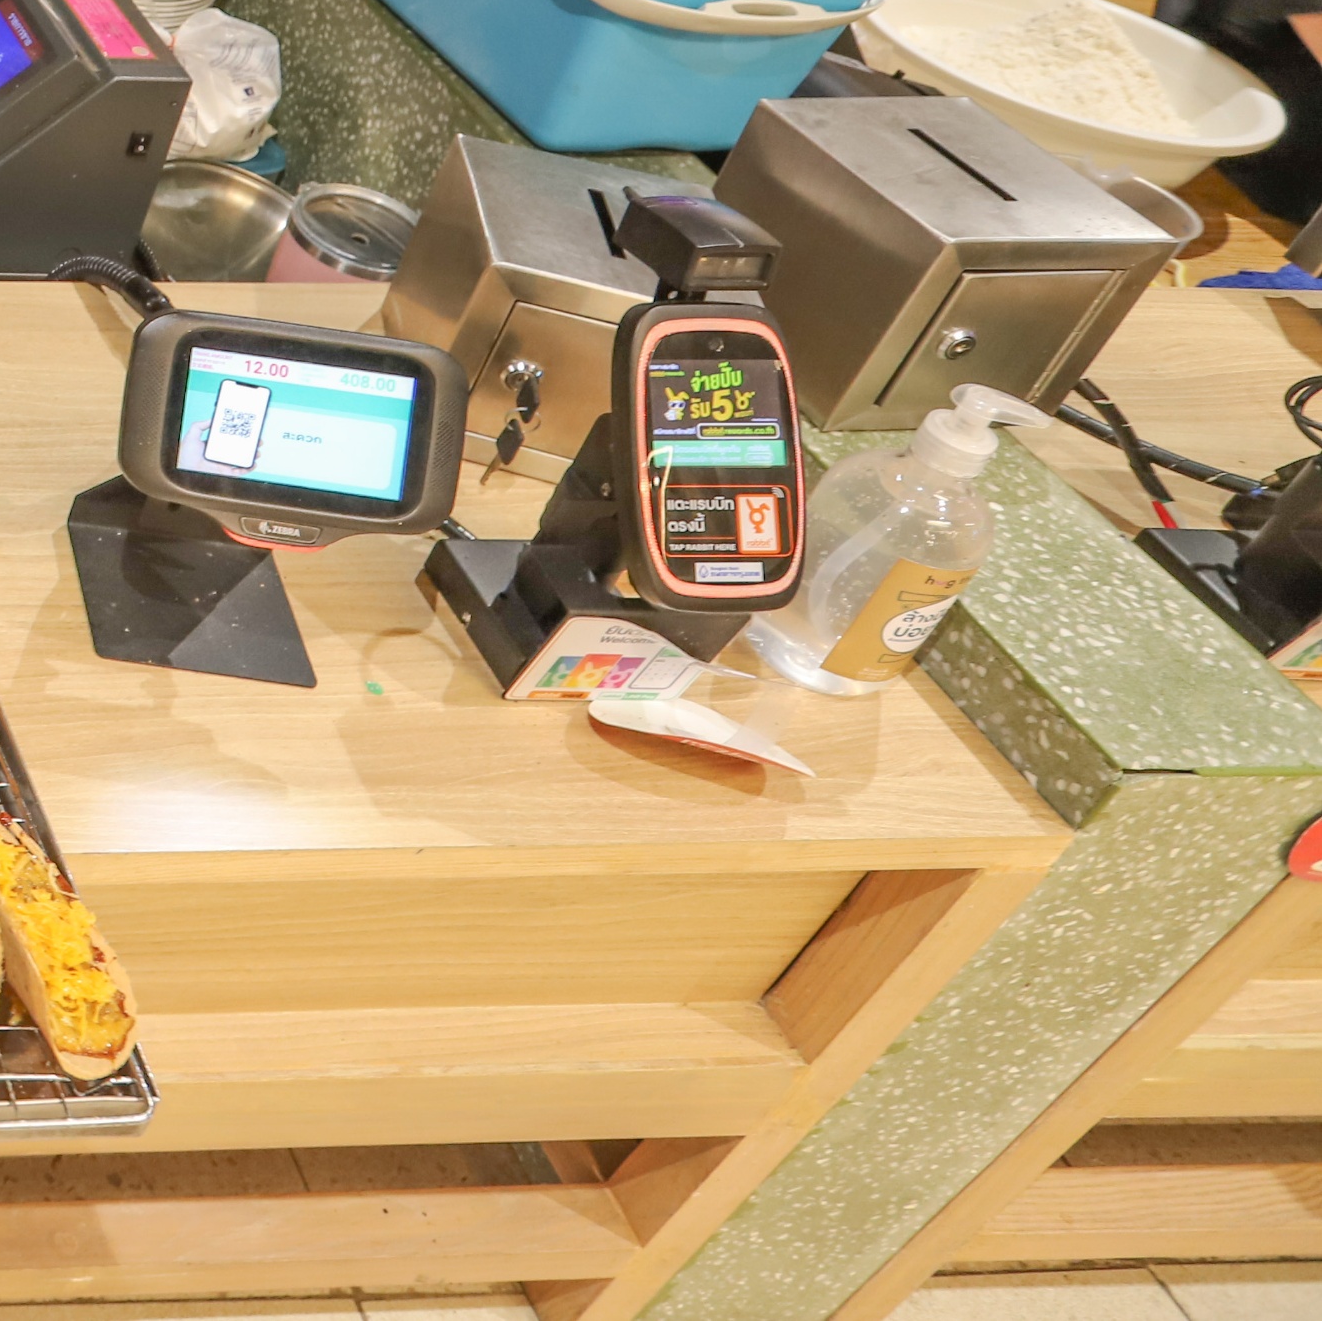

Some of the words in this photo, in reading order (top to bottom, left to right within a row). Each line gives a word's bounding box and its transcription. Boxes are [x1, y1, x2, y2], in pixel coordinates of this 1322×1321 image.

[244, 360, 289, 378] 12.00
[340, 372, 396, 393] 408.00
[712, 389, 734, 421] 5
[667, 513, 705, 532] ตรงนี้
[669, 543, 685, 551] TAP
[685, 543, 715, 551] RABBIT
[715, 543, 737, 551] HERE
